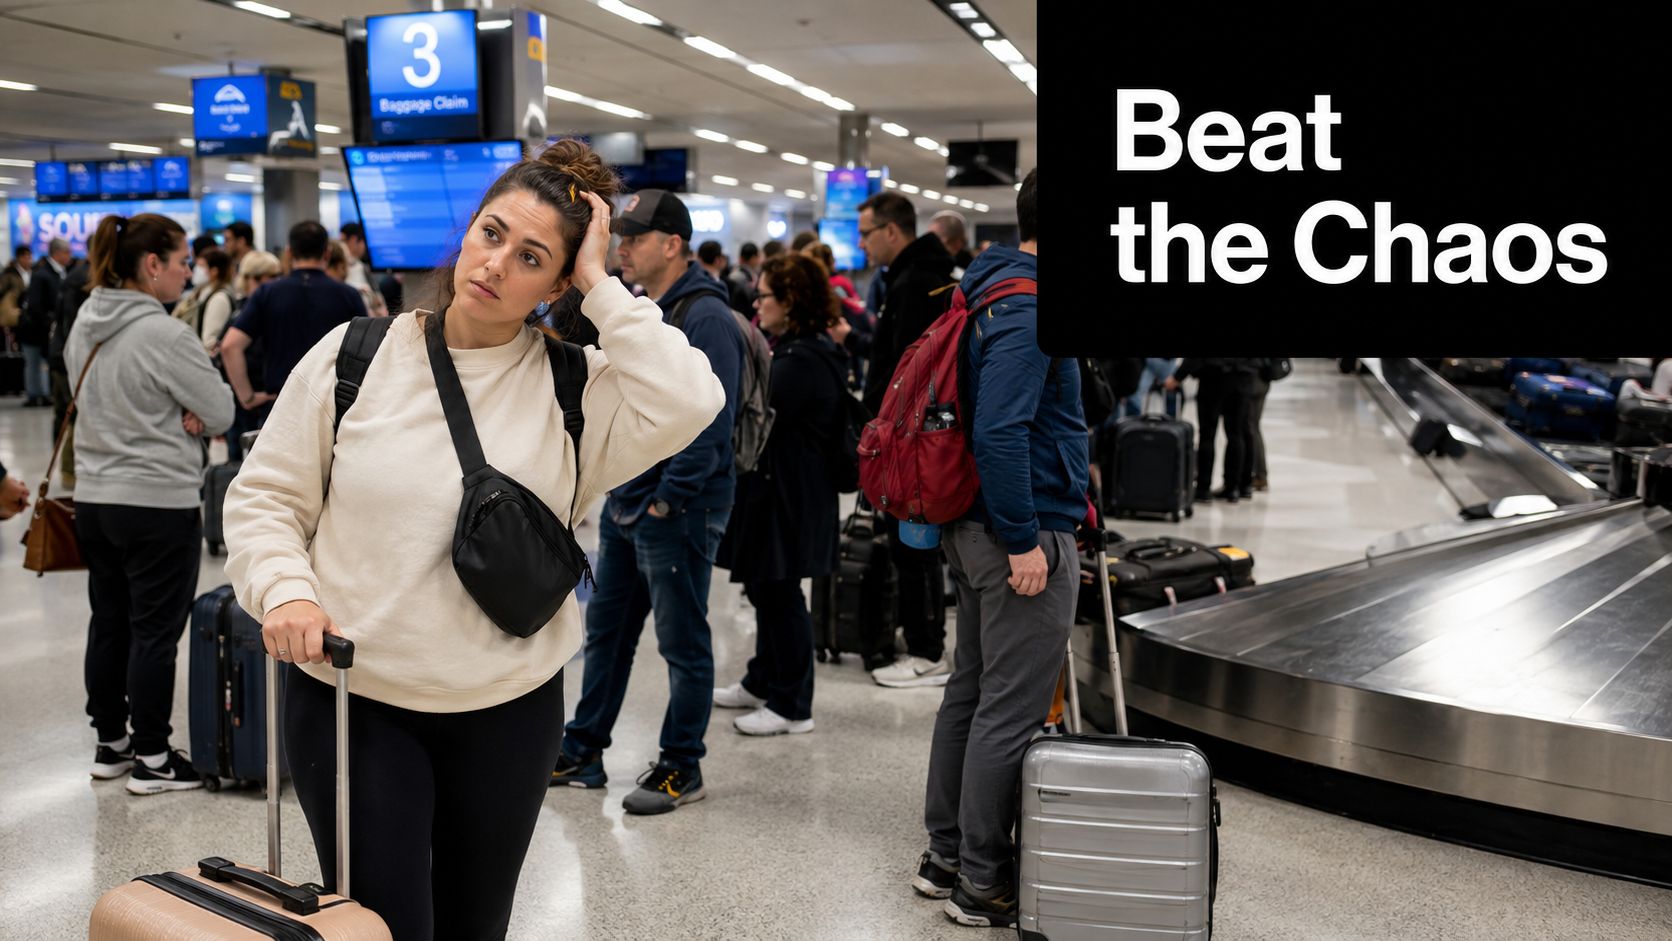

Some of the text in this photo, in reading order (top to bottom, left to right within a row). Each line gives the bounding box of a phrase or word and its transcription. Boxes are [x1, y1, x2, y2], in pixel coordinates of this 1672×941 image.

[402, 22, 441, 88] 3
[379, 95, 469, 114] Baggage Claim
